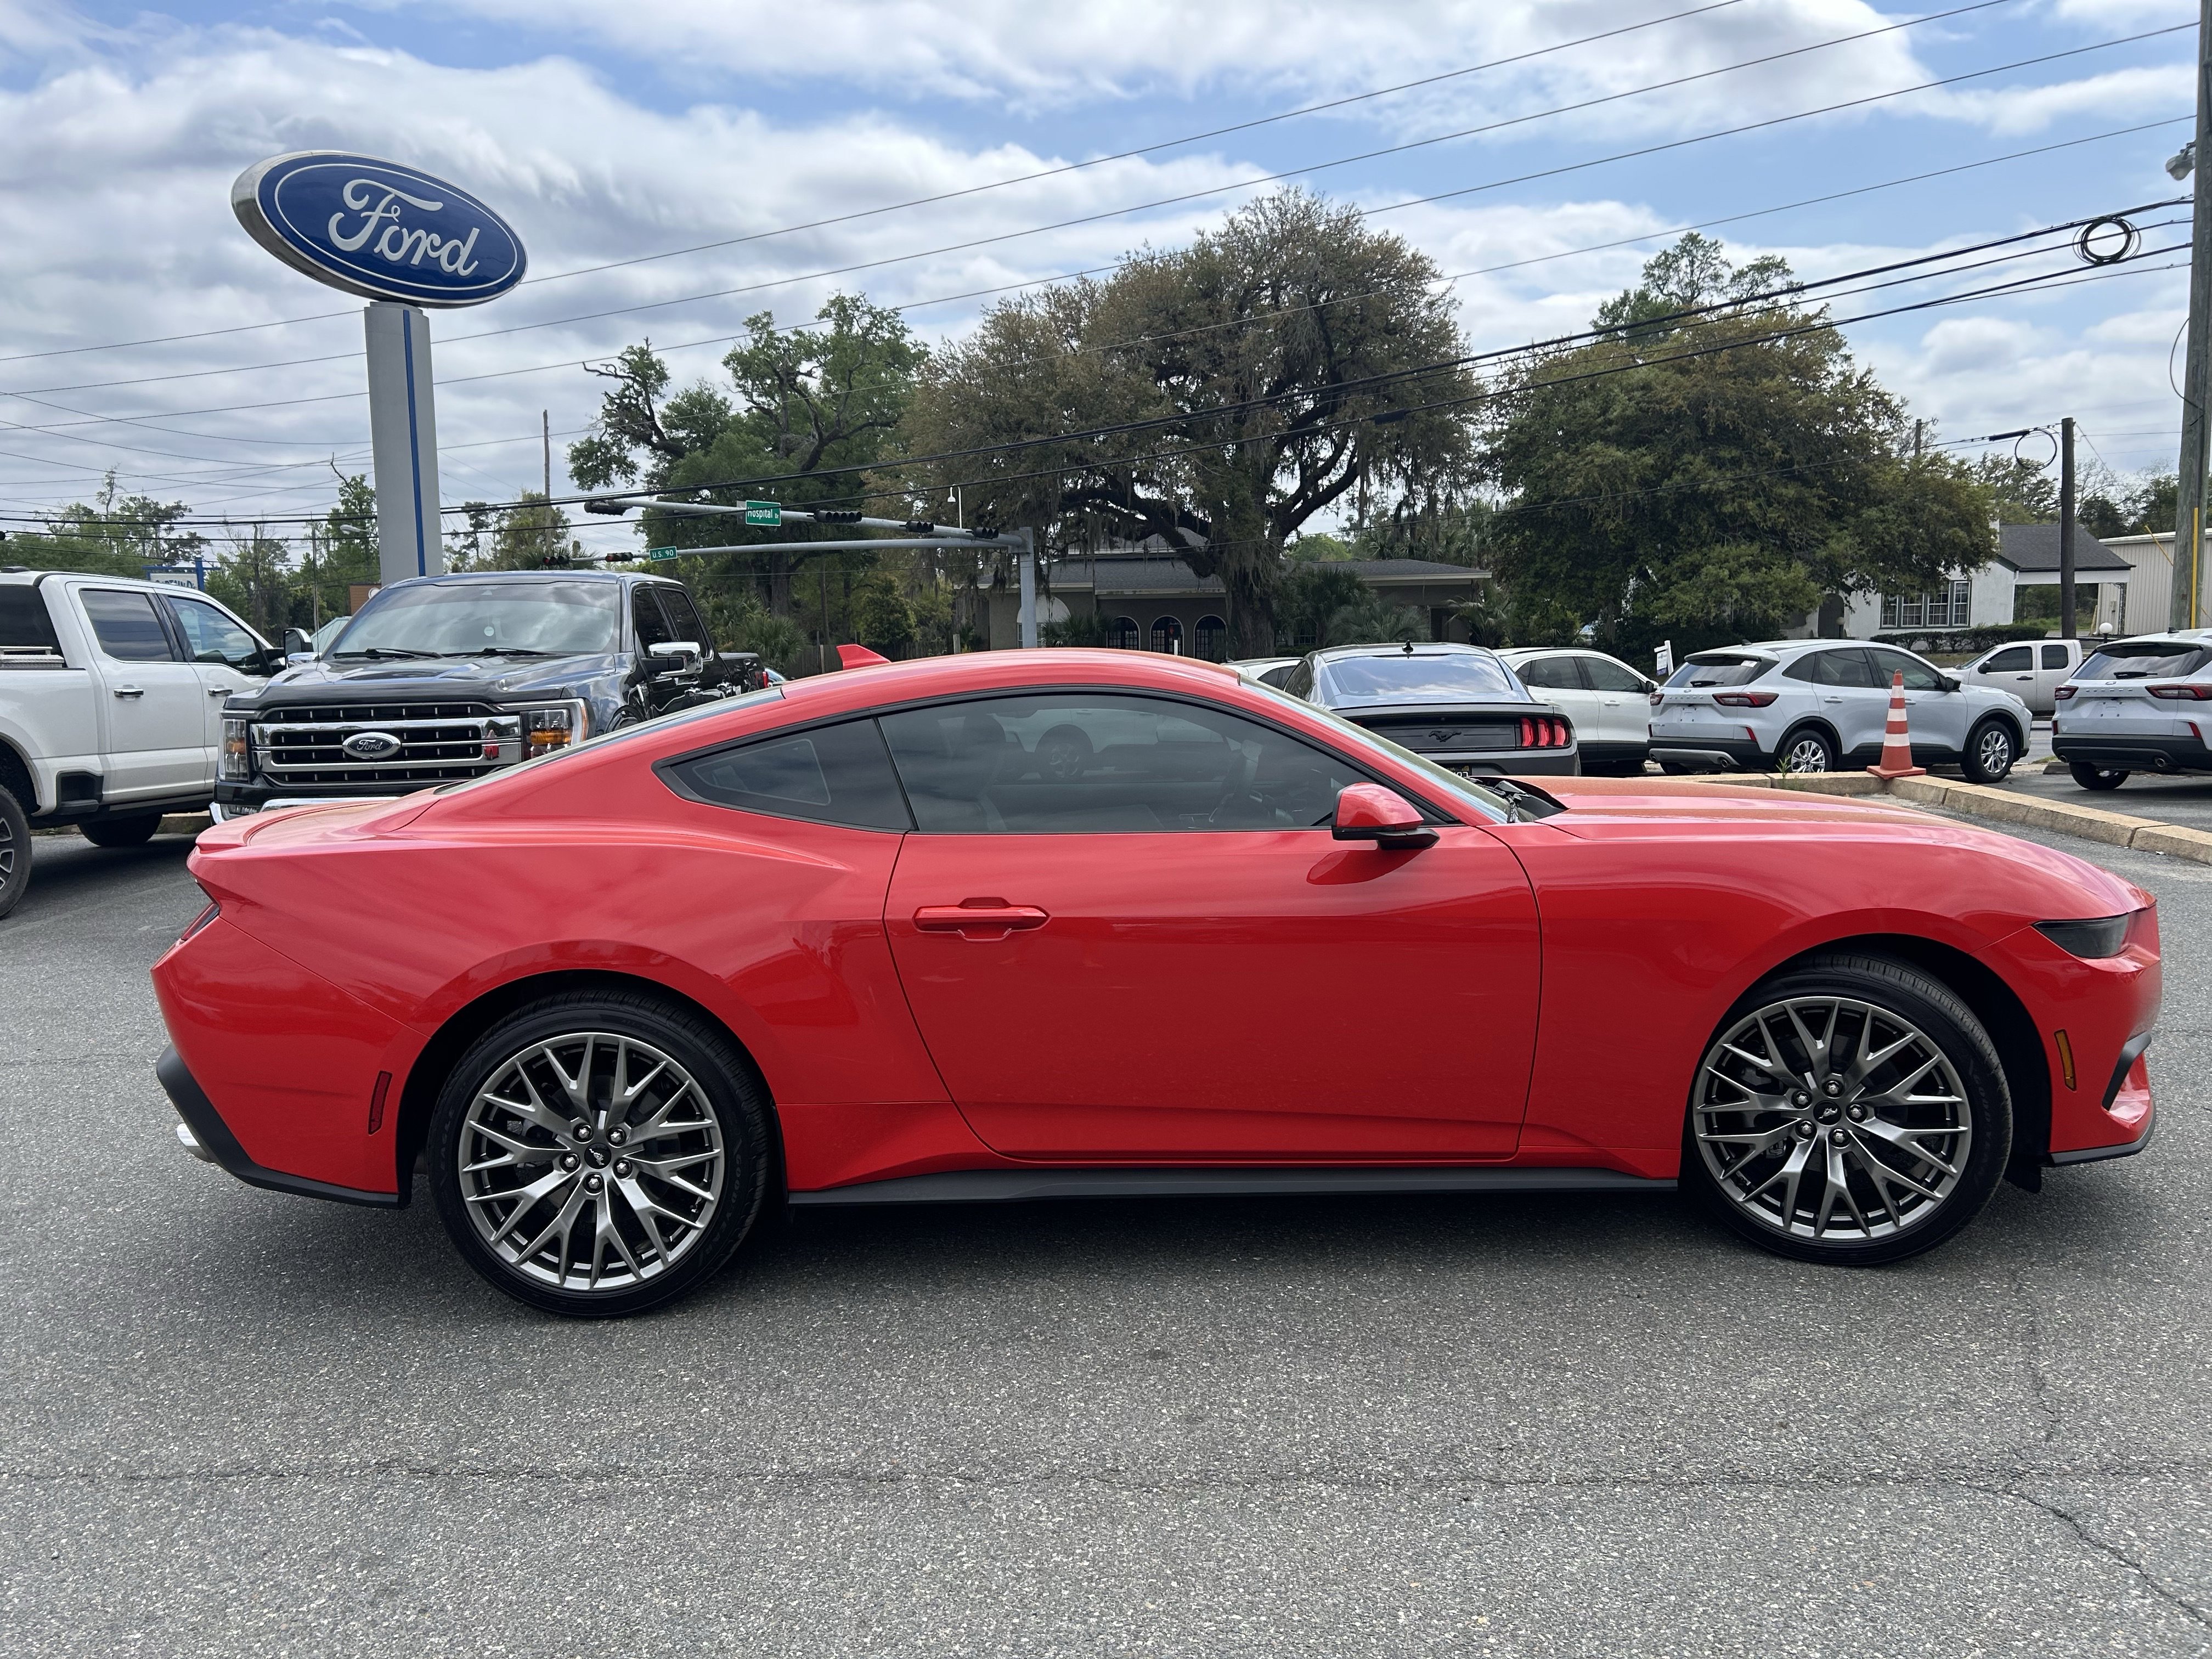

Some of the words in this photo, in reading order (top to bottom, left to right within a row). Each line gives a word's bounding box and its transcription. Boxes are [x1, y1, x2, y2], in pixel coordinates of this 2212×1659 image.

[328, 179, 480, 276] Ford
[748, 507, 773, 520] Hospital
[357, 739, 383, 751] Ford
